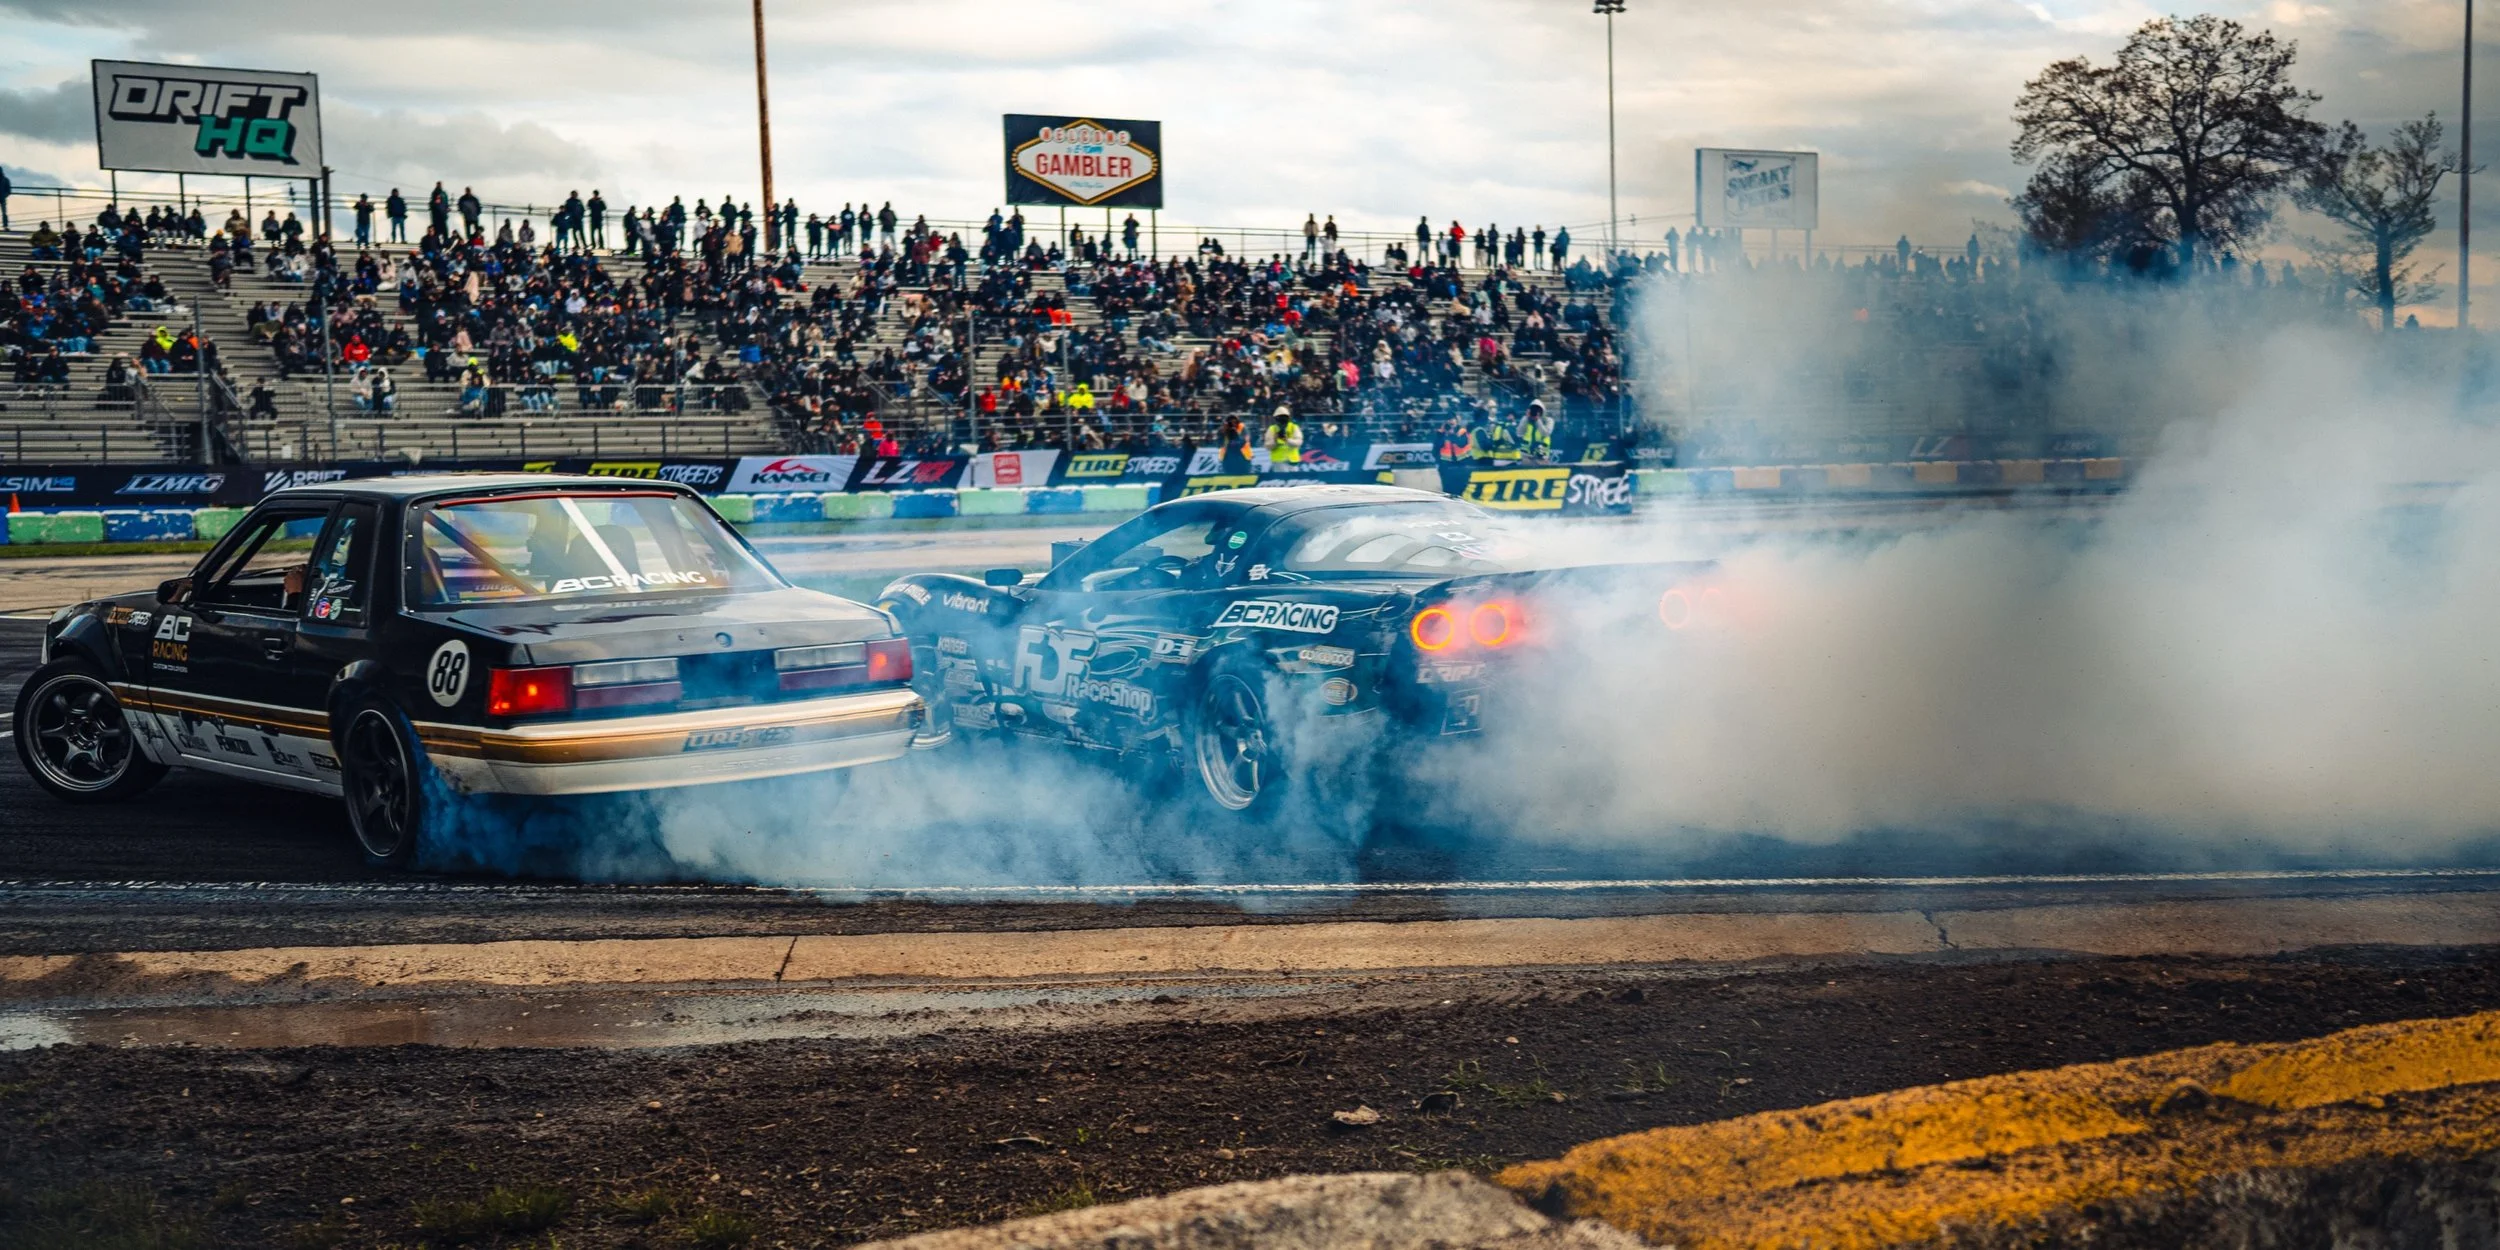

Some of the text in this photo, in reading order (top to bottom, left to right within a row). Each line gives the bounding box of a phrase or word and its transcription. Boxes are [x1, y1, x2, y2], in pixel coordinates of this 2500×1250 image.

[109, 75, 307, 123] DRIFT
[195, 113, 299, 165] HQ
[1036, 153, 1132, 178] GAMBLER
[1067, 455, 1181, 476] TIRE STREETS
[1297, 461, 1350, 473] ANSEI
[1406, 452, 1436, 463] RAC
[293, 470, 347, 482] DRIFT
[659, 464, 724, 485] STREETS
[750, 472, 830, 484] KANSEI
[860, 460, 918, 484] LZ
[117, 474, 224, 494] LZMFG
[1465, 473, 1632, 508] TIRE STREE
[943, 592, 990, 614] vibrant
[154, 614, 193, 641] BC
[152, 641, 188, 661] RACING
[432, 650, 466, 696] 88
[1066, 676, 1150, 716] RaceShop
